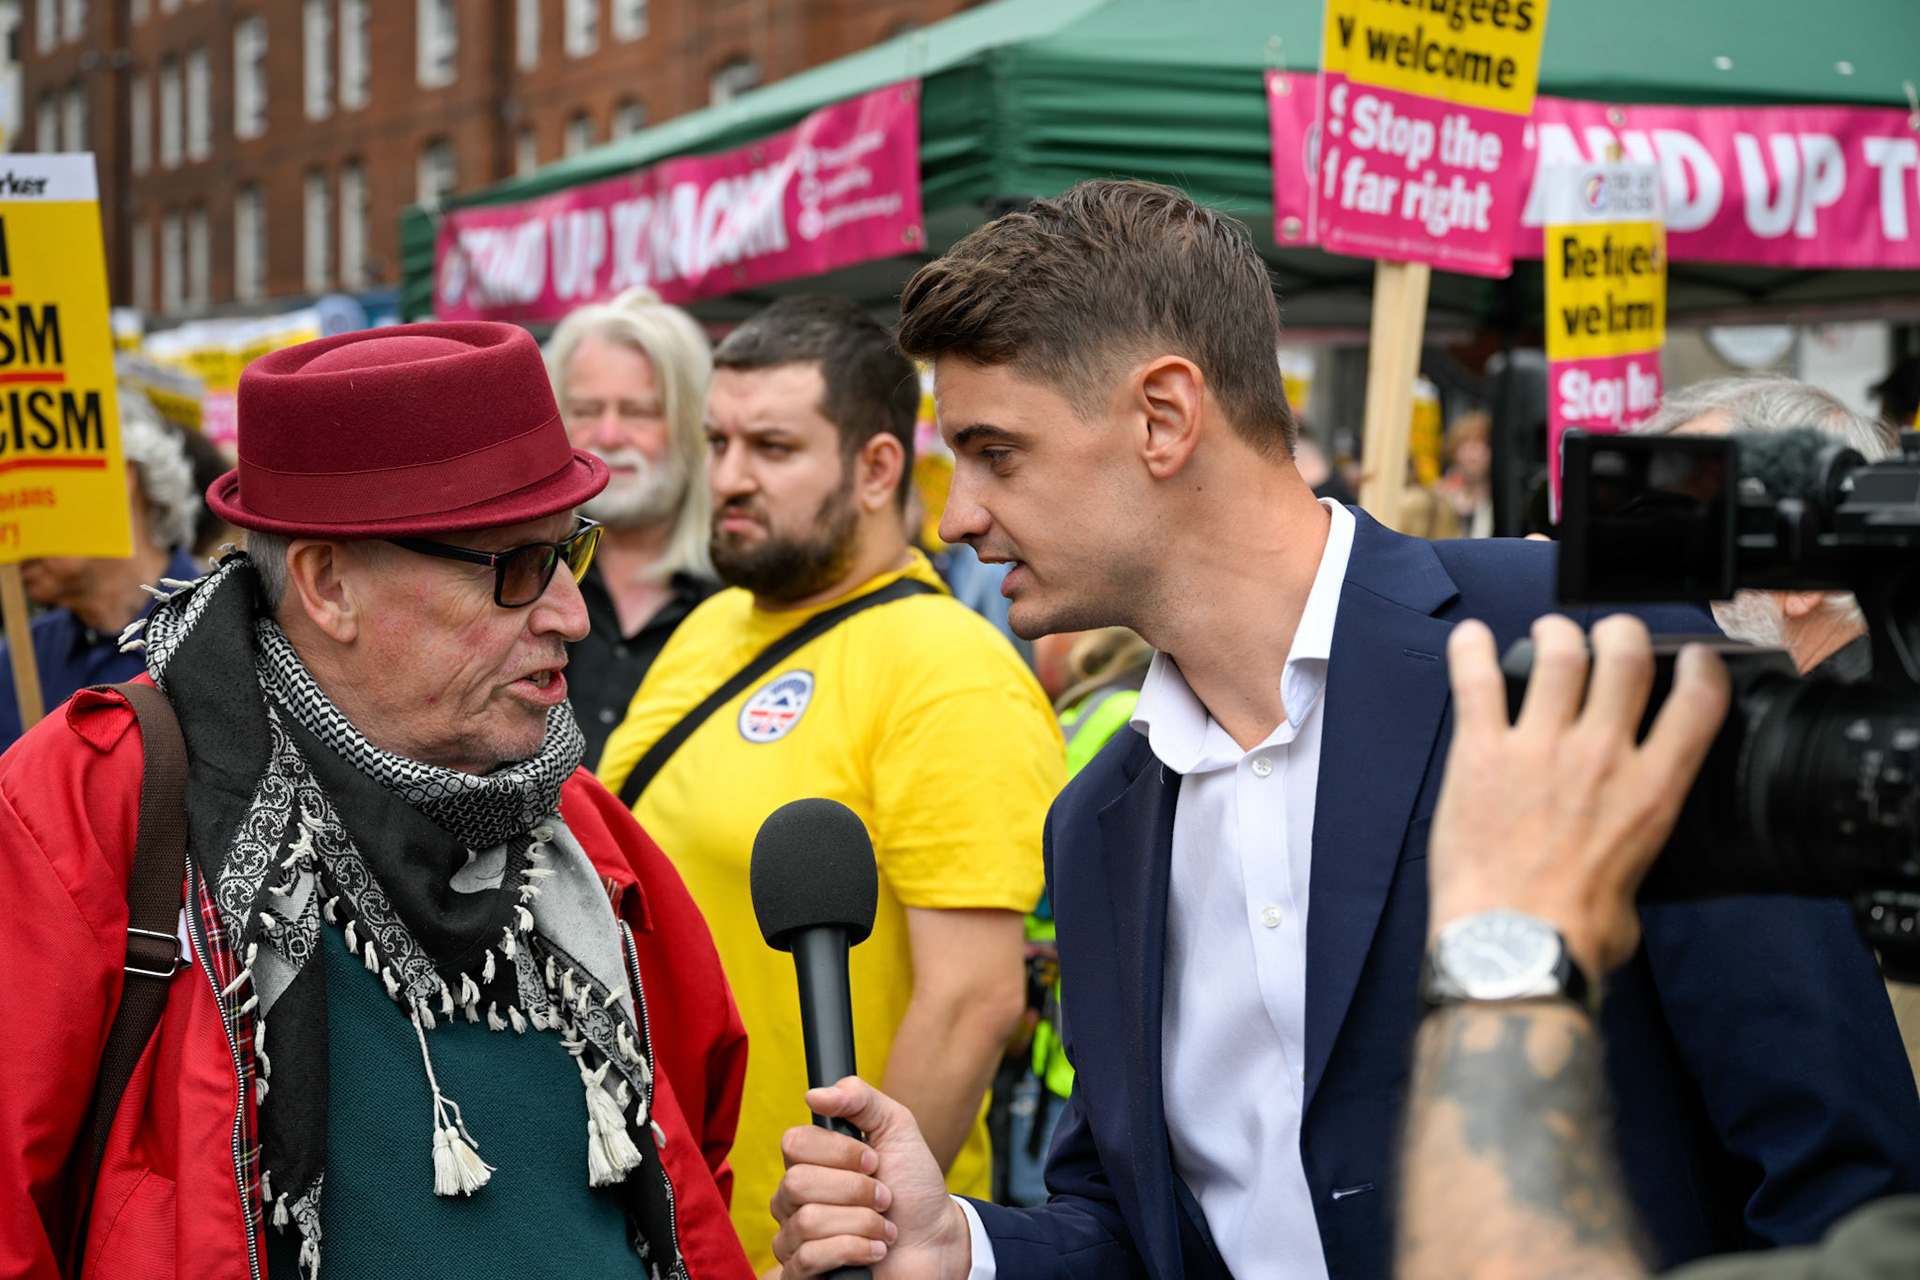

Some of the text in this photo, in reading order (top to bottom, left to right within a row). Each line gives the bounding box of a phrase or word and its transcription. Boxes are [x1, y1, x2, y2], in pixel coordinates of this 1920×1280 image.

[1366, 26, 1516, 88] welcome
[1350, 94, 1435, 171] Stop
[1439, 114, 1502, 172] the
[1340, 155, 1400, 215] far
[1401, 169, 1493, 237] right
[1733, 132, 1847, 239] UP
[1862, 136, 1920, 240] T
[0, 390, 105, 452] ISM
